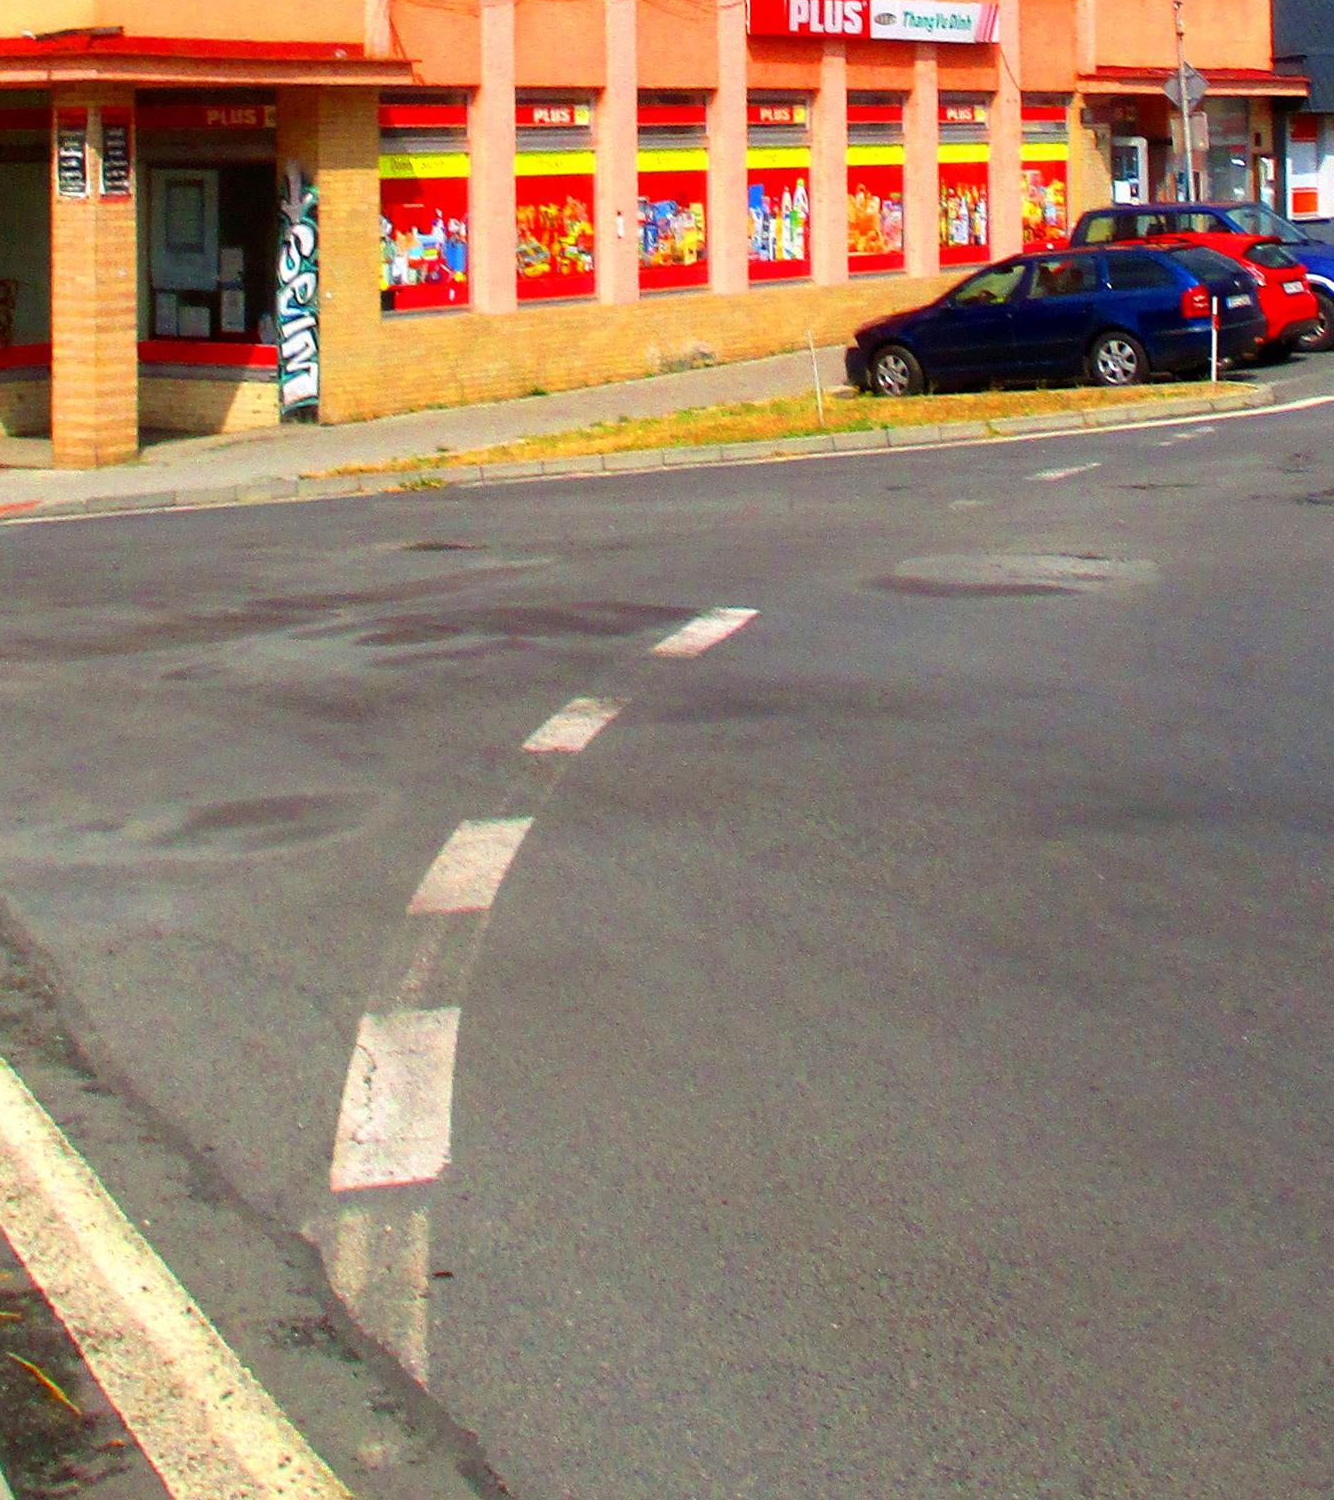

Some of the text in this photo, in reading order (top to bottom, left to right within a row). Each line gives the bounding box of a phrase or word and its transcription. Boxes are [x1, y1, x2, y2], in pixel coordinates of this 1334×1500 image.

[207, 108, 256, 125] PLUS
[533, 108, 570, 123] PLUS
[759, 107, 790, 121] PLUS
[946, 107, 972, 121] PLUS
